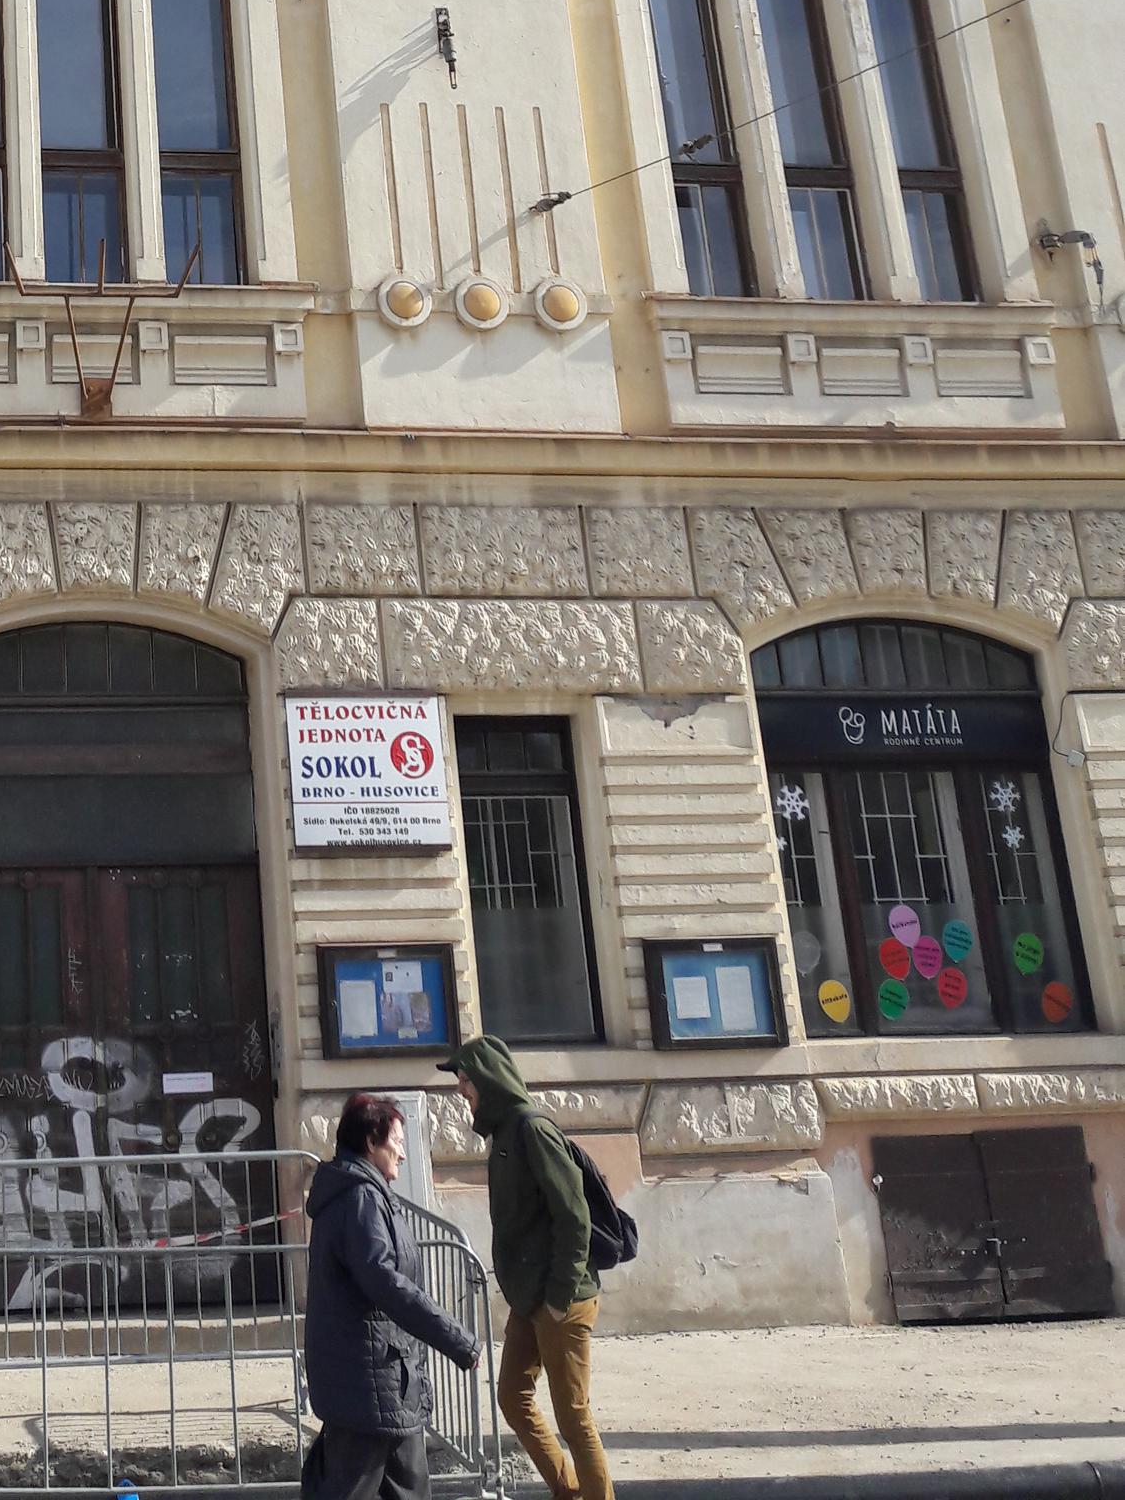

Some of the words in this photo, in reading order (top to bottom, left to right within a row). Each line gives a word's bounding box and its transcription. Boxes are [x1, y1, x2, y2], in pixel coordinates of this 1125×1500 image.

[295, 700, 428, 721] TĚLOCVIČNÁ
[880, 703, 962, 737] MATÁTA
[298, 727, 387, 744] JEDNOTA
[883, 736, 921, 747] RODINNÉ
[924, 736, 965, 746] CENTRUM
[301, 755, 382, 780] SOKOL
[301, 786, 346, 799] BRNO
[360, 785, 440, 798] HUSOVICE
[343, 805, 359, 816] IČO
[302, 817, 328, 826] Sídlo:
[329, 816, 368, 826] Dukelská
[393, 817, 409, 826] 614
[410, 817, 422, 826] 00
[423, 816, 442, 826] Brno
[338, 827, 353, 837] Tel.
[359, 827, 375, 837] 530
[376, 827, 392, 837] 343
[394, 827, 410, 837] 149
